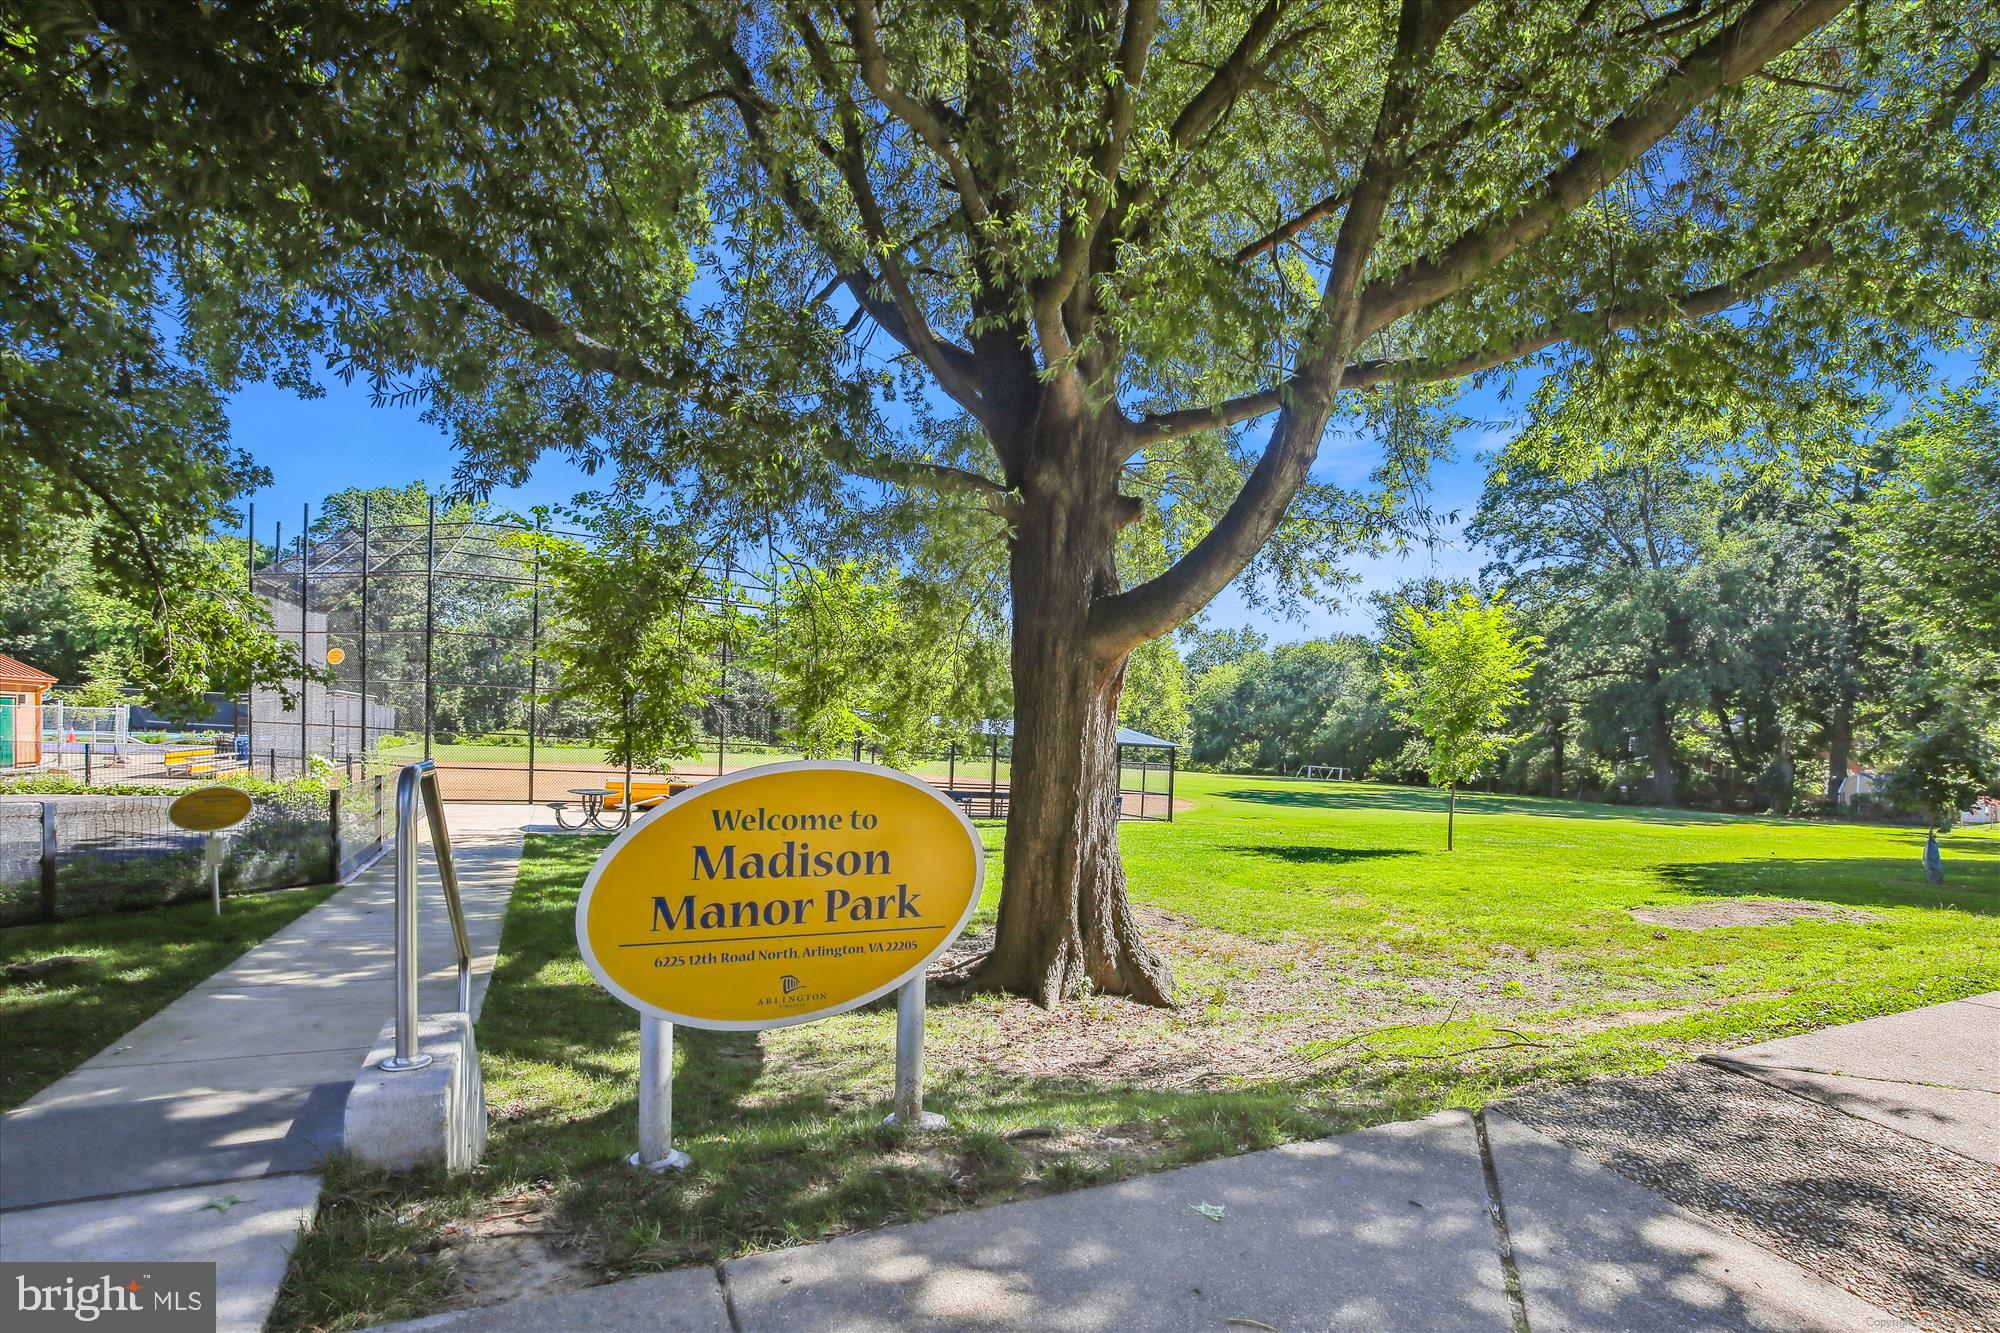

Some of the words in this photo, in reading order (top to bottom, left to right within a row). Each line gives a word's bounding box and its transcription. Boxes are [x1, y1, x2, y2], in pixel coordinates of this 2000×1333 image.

[711, 807, 843, 832] Welcome
[850, 809, 878, 830] to
[691, 841, 890, 881] Madison
[650, 894, 814, 932] Manor
[824, 884, 922, 923] Park
[654, 956, 686, 968] 6225
[689, 952, 717, 966] 12th
[721, 950, 755, 964] Road
[868, 941, 884, 953] VA
[886, 940, 918, 952] 22205
[757, 992, 828, 1006] ARLINGTON
